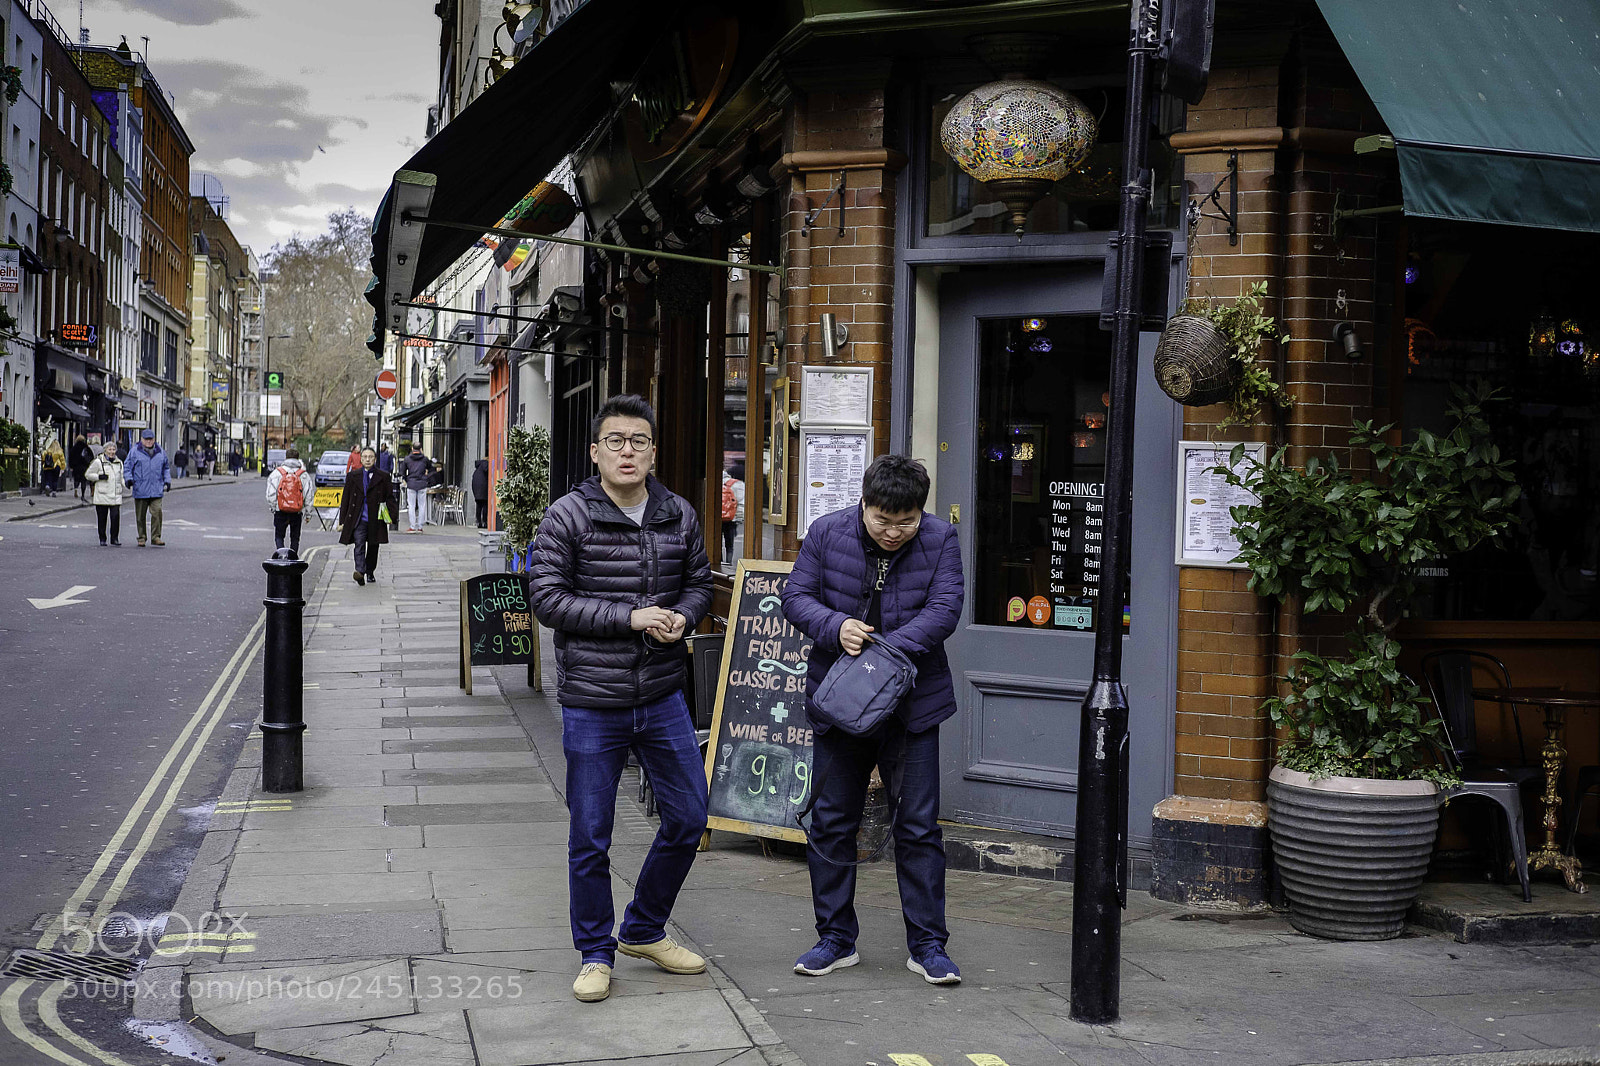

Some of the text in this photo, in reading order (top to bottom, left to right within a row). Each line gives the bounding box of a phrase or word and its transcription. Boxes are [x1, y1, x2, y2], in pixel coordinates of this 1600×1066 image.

[1049, 481, 1105, 496] OPENING T
[1052, 500, 1103, 512] Mon 8am
[1053, 514, 1103, 526] Tue 8am
[1052, 527, 1102, 540] Wed 8am
[1051, 541, 1101, 554] Thu 8am
[1051, 555, 1100, 569] Fri 8am
[1050, 569, 1100, 582] Sat 8am
[479, 578, 523, 598] FISH
[745, 577, 781, 596] STEAK
[1050, 582, 1065, 594] Sun
[483, 596, 527, 613] CHIPS
[502, 611, 531, 622] BEER
[504, 621, 531, 632] WINE
[747, 639, 782, 660] FISH
[783, 651, 800, 663] AND
[729, 670, 807, 693] CLASSIC BU
[728, 721, 769, 742] WINE
[787, 725, 814, 747] BEE
